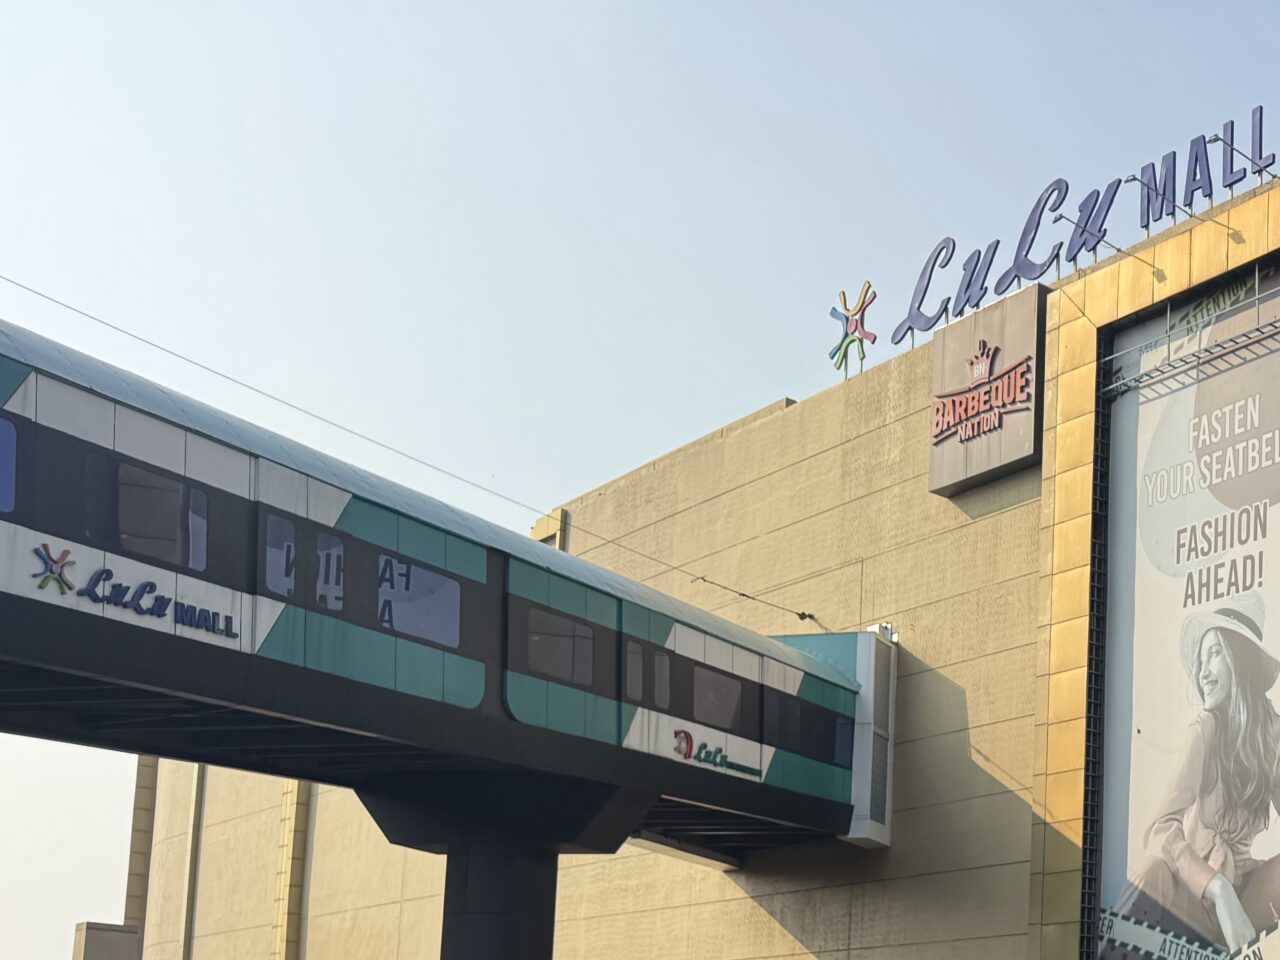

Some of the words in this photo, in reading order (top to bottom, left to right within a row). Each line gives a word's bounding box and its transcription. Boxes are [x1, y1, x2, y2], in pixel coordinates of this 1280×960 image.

[891, 178, 1121, 345] LuLu
[1140, 105, 1275, 229] MALL
[1186, 280, 1248, 335] ATTENTION
[933, 363, 1032, 437] BARBEQUE
[958, 410, 1002, 442] NATION
[1188, 393, 1260, 453] FASTEN
[1144, 462, 1195, 507] YOUR
[1176, 501, 1268, 565] FASHION
[77, 568, 173, 618] LuLu
[175, 602, 239, 639] MALL
[1183, 551, 1263, 608] AHEAD!
